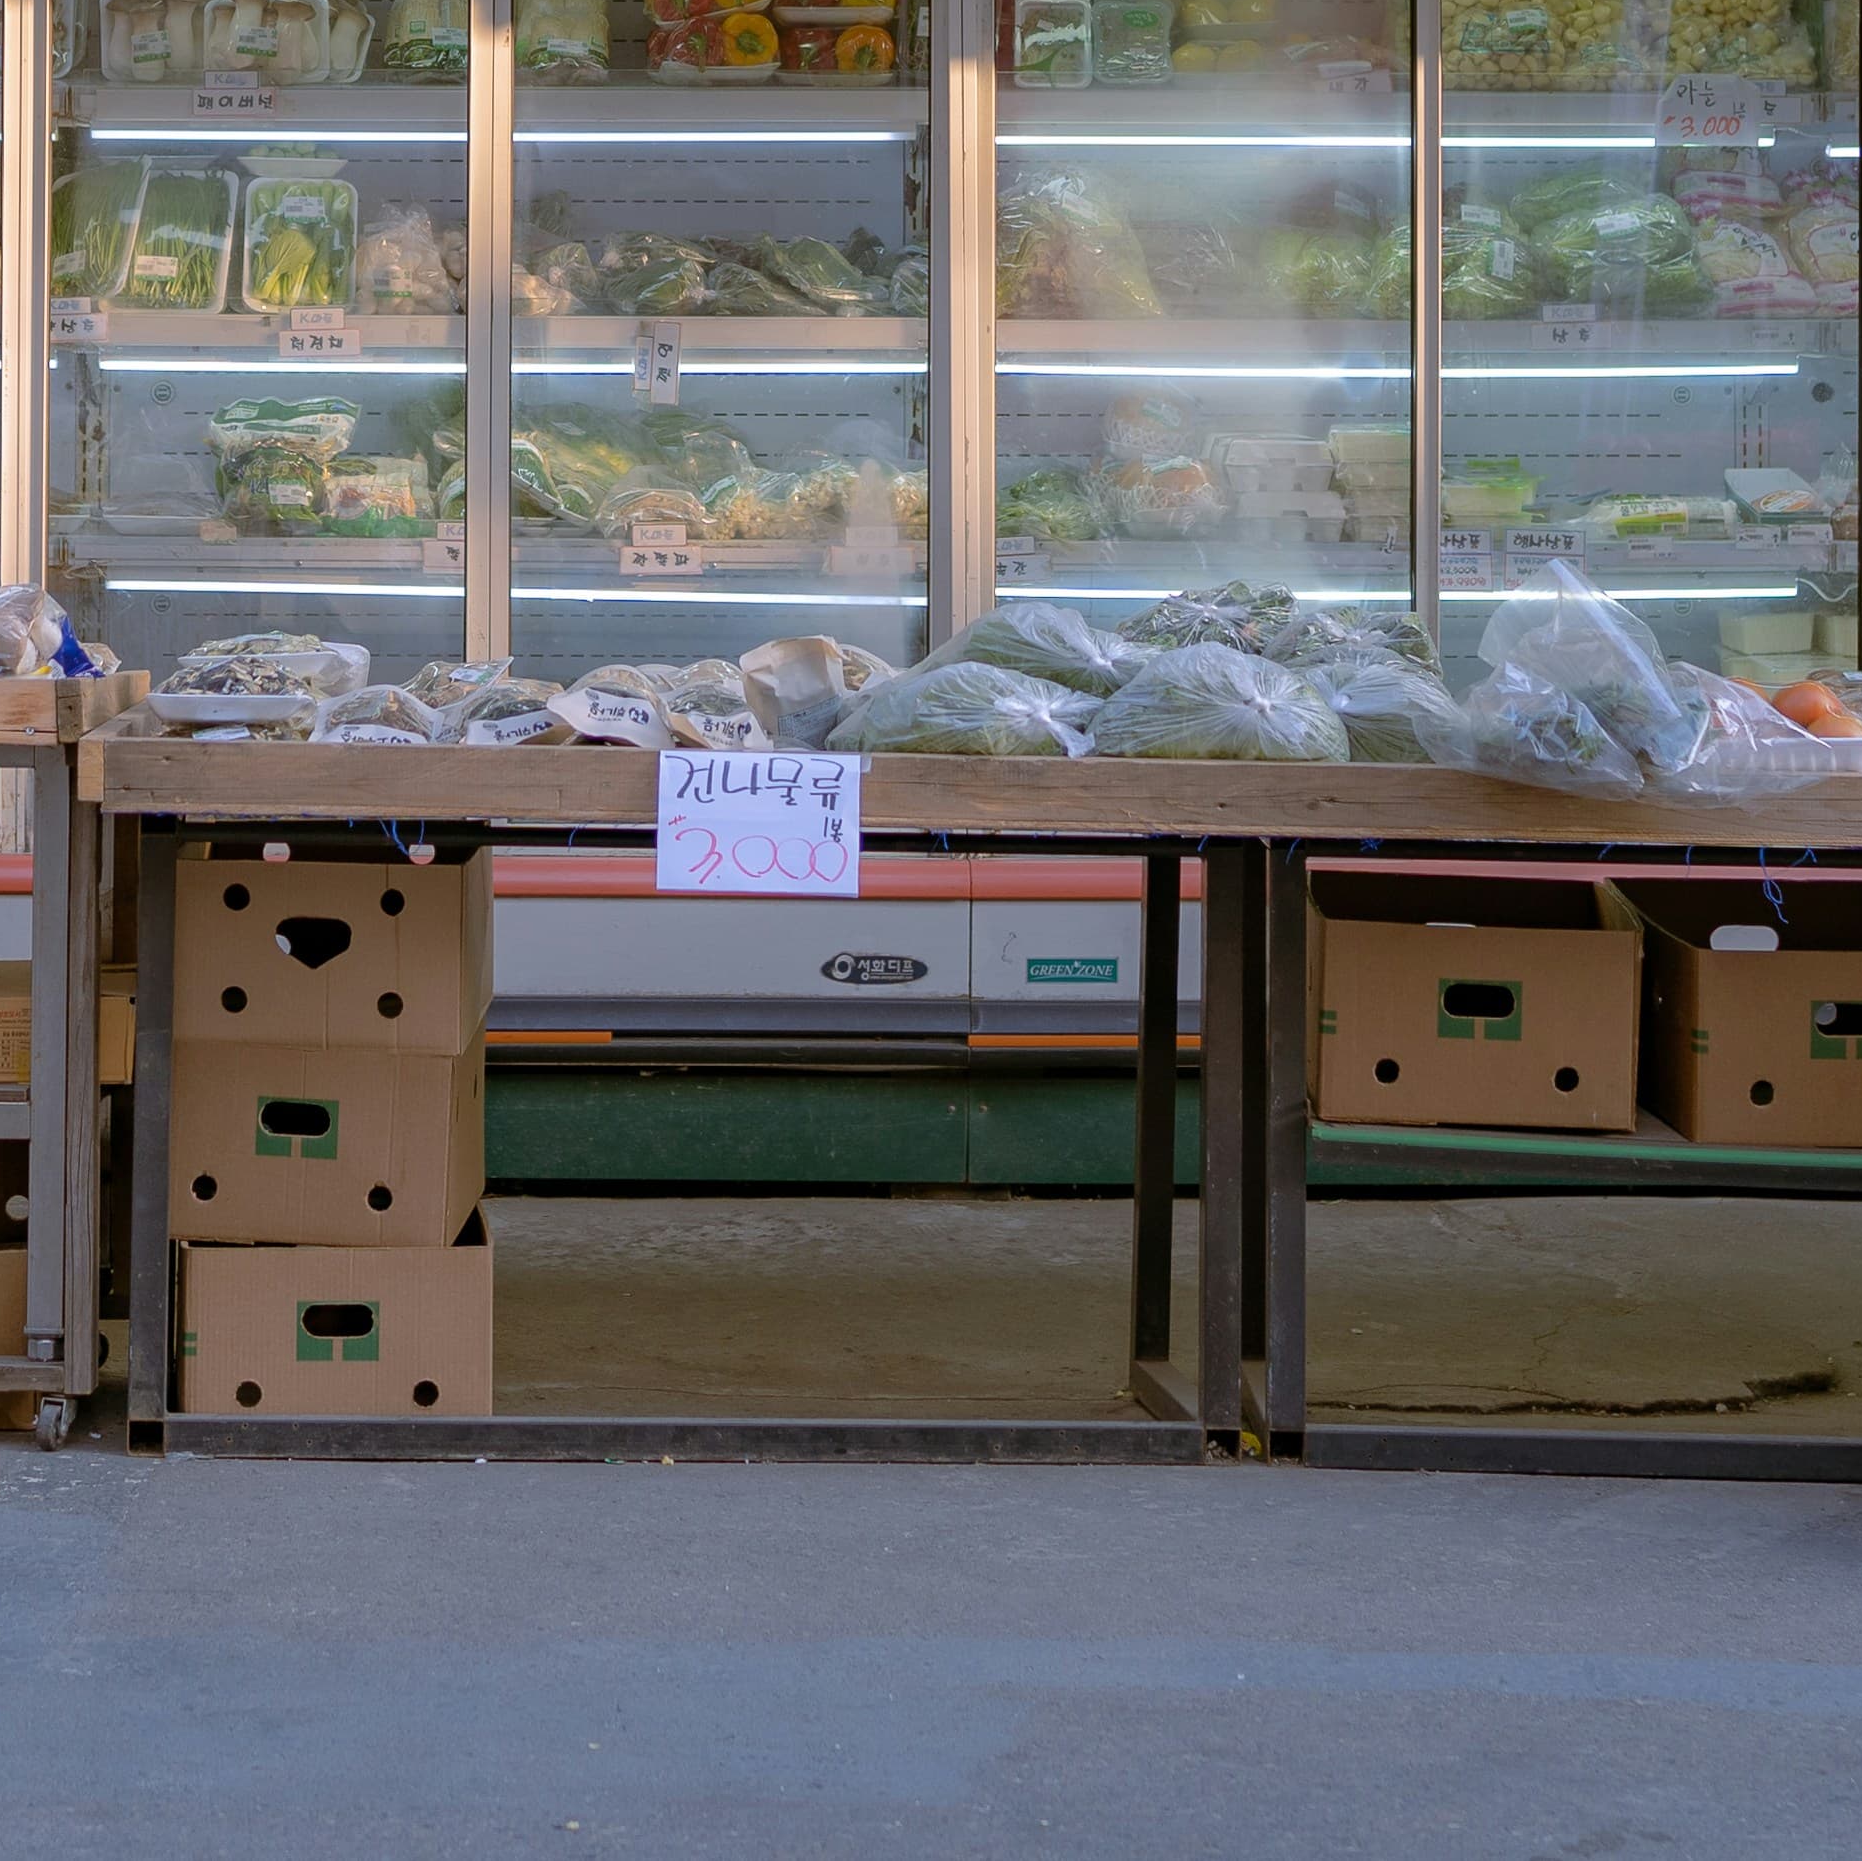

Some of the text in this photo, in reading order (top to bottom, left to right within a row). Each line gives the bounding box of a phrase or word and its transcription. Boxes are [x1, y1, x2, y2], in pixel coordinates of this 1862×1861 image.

[664, 754, 846, 812] 건나물류
[856, 958, 915, 974] 성화디프
[1029, 963, 1115, 977] GREEN ZONE
